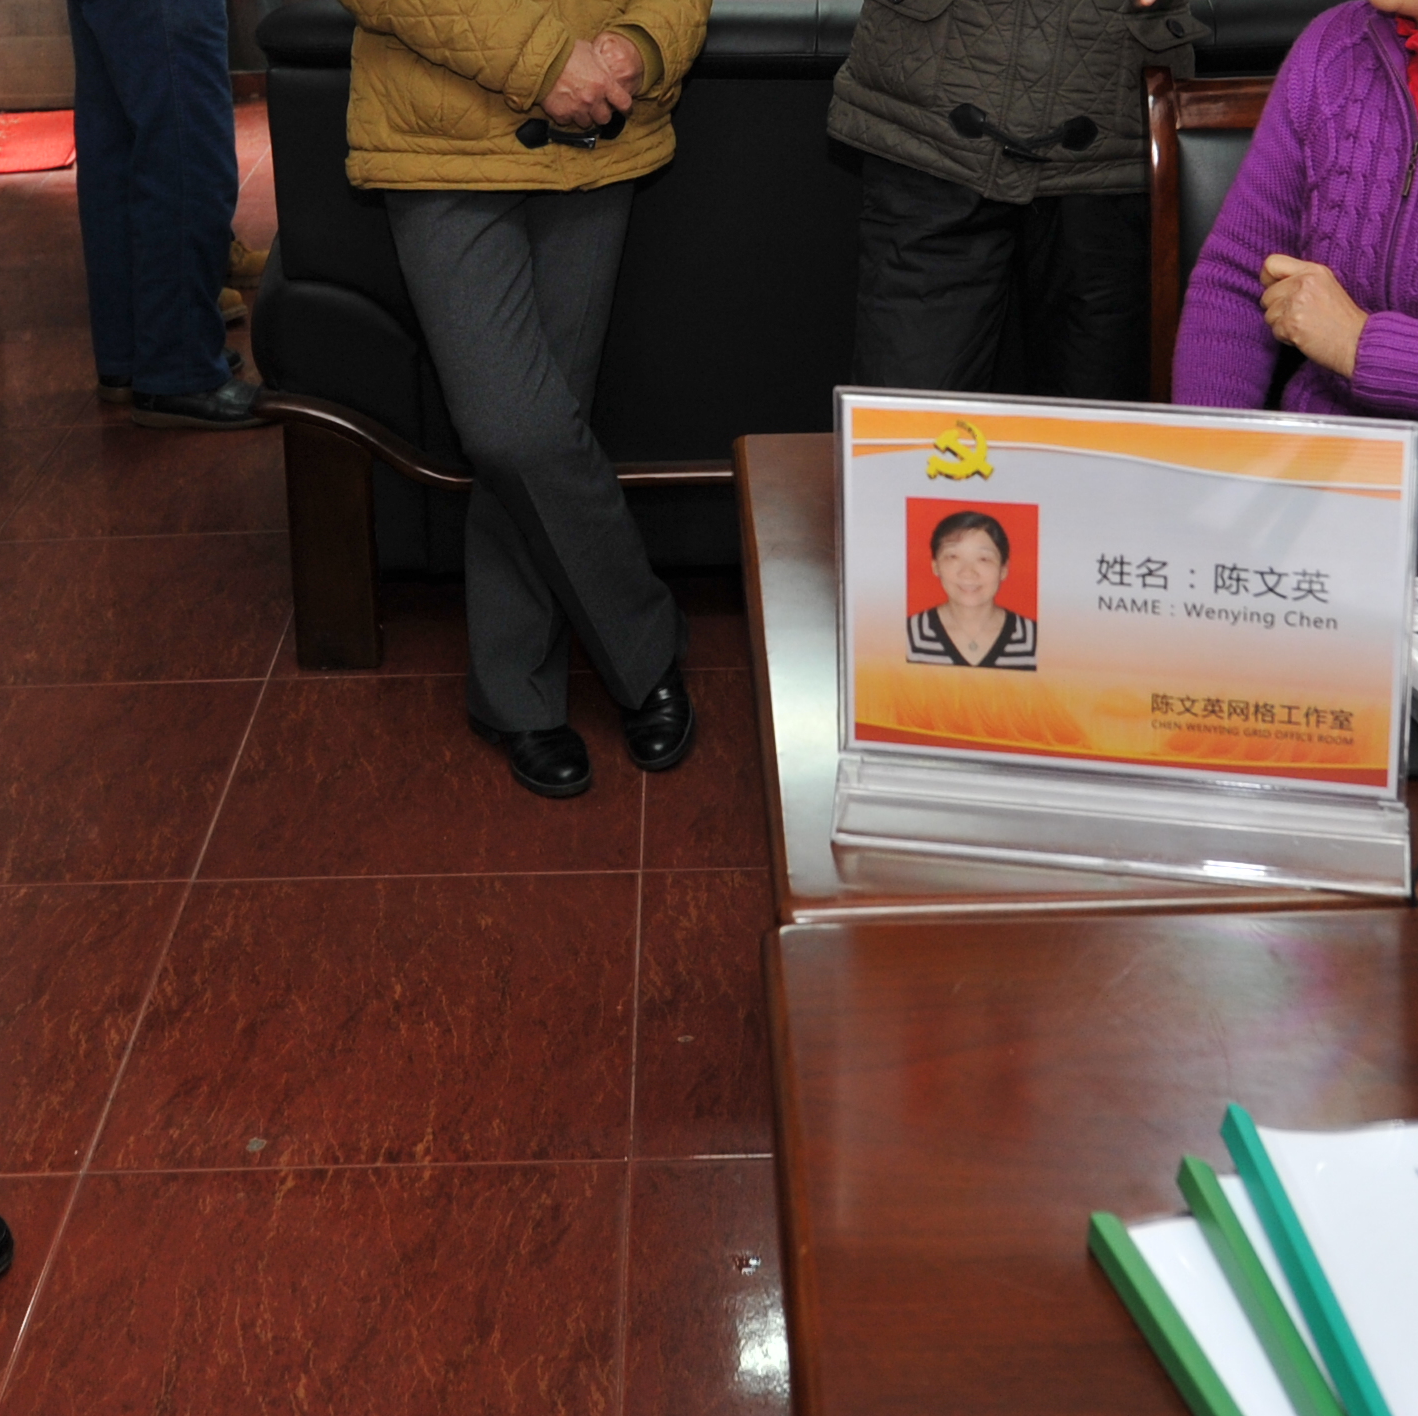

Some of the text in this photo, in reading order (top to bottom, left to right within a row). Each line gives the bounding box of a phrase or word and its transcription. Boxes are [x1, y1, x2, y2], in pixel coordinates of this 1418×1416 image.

[1096, 553, 1331, 604] 姓名：陈文英
[1183, 601, 1276, 630] Wenying
[1284, 610, 1338, 630] Chen
[1151, 692, 1355, 732] 陈文英网格工作室
[1151, 718, 1181, 731] CHEN
[1186, 721, 1240, 736] WENYING
[1243, 726, 1272, 739] GRID
[1317, 734, 1355, 746] ROOM
